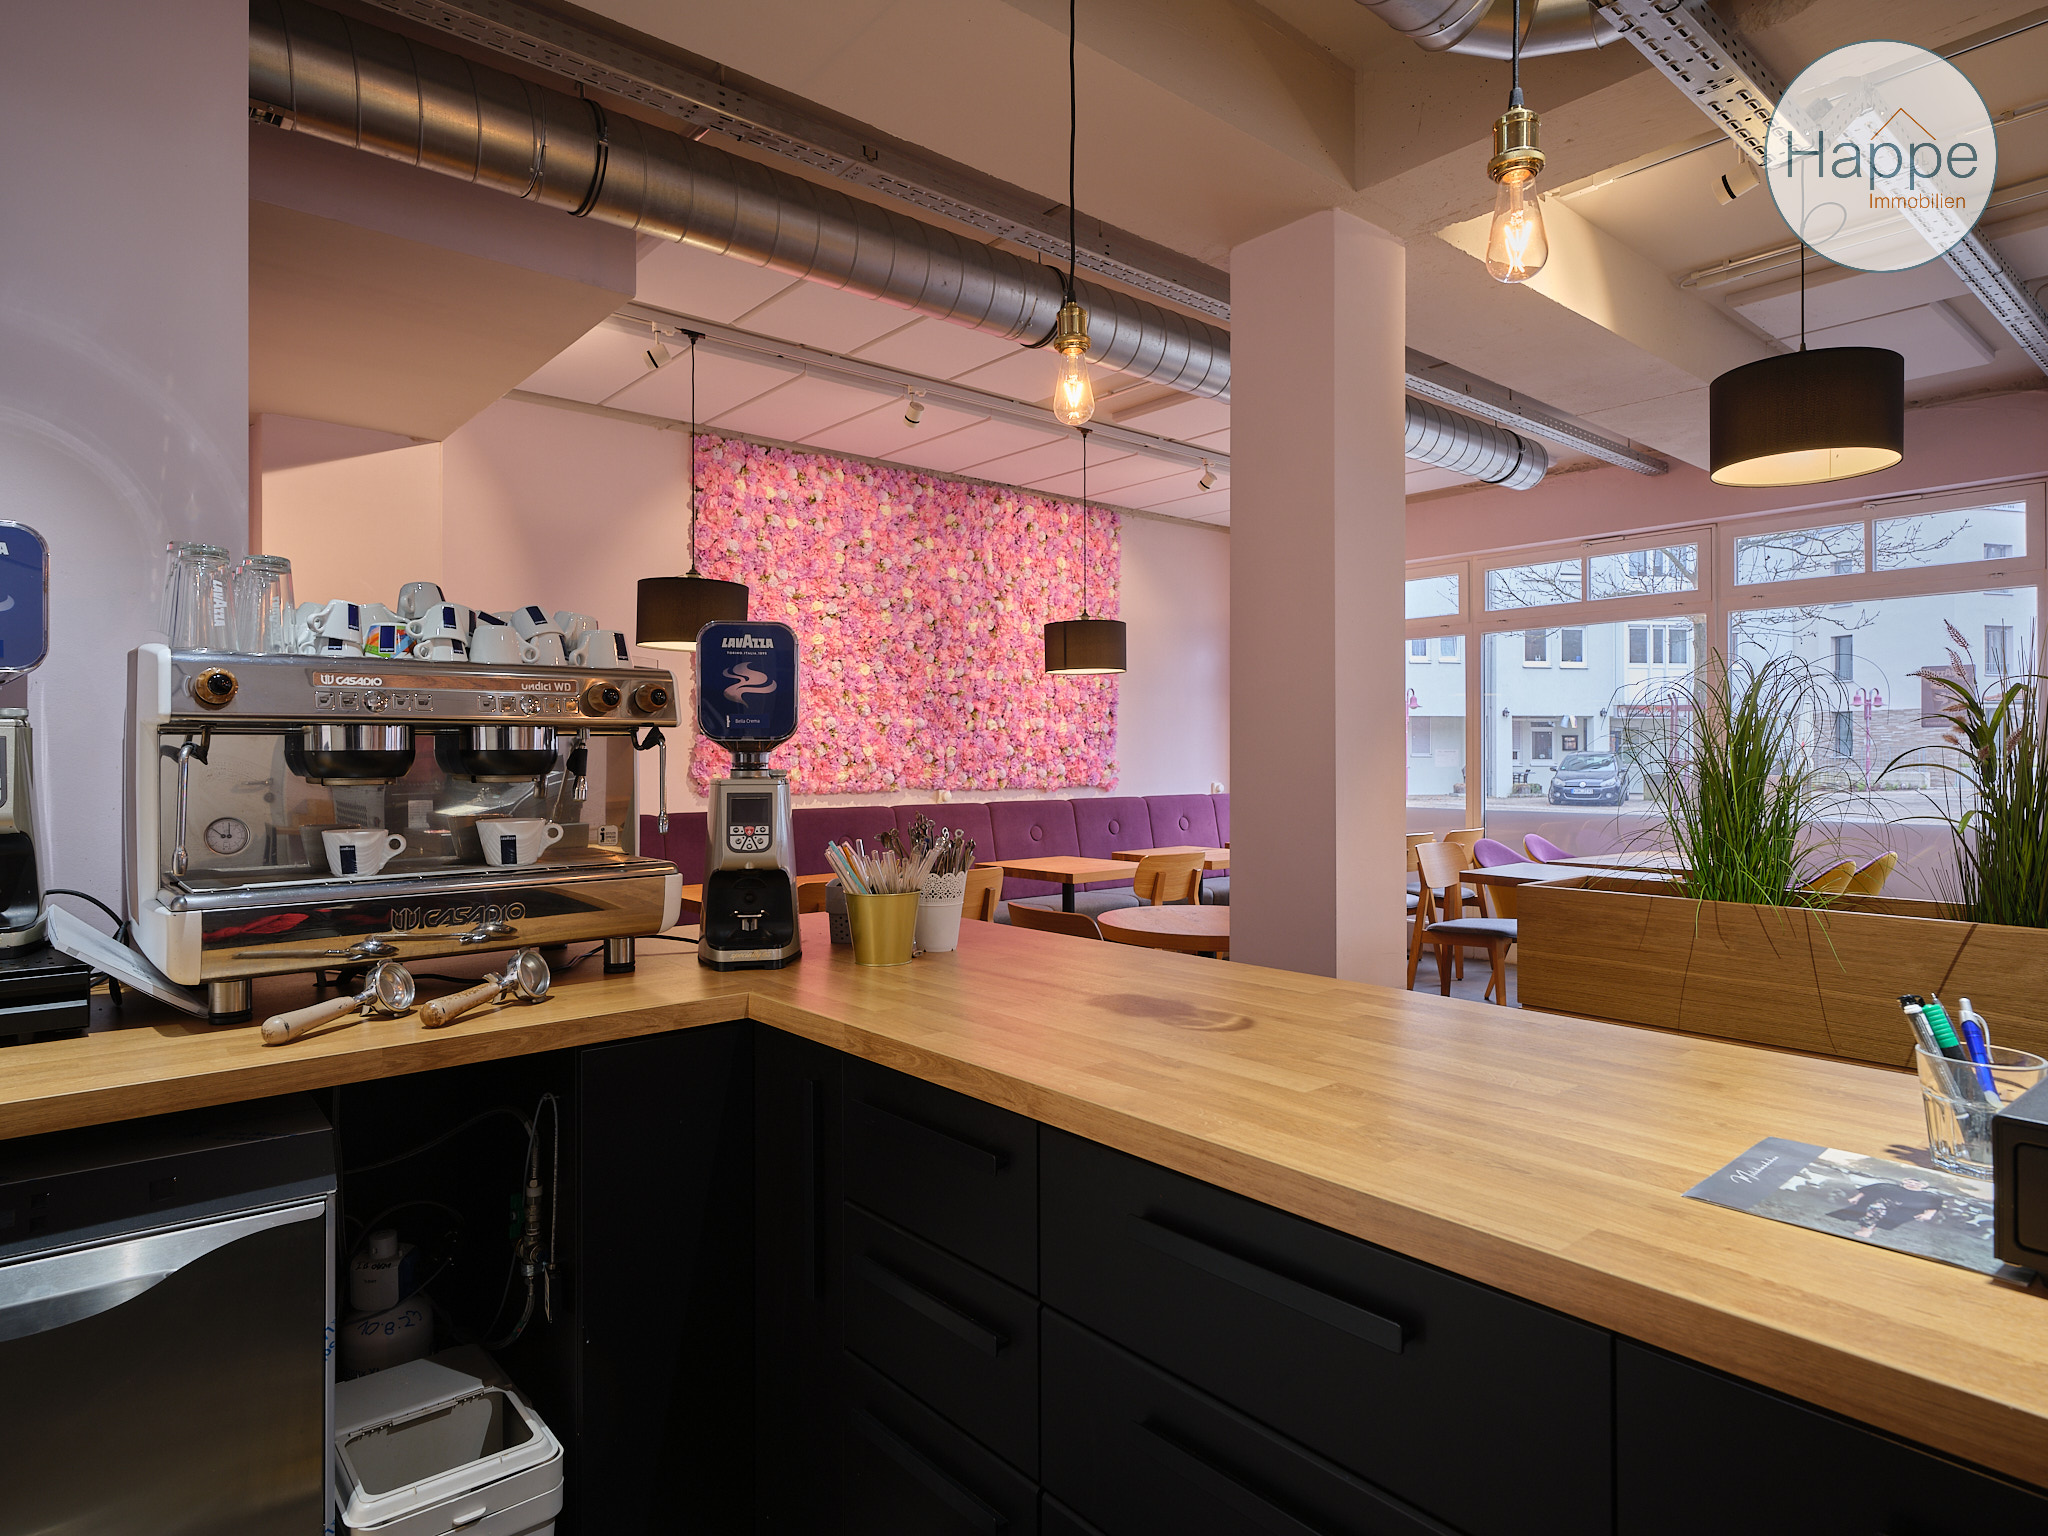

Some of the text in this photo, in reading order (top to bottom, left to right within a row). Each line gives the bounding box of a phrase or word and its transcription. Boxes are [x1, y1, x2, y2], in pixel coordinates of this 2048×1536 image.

[212, 579, 228, 627] LAVAZZA
[721, 633, 774, 649] LAVAZZA
[335, 676, 383, 687] CASADIO
[554, 682, 572, 692] WD
[424, 901, 526, 928] CASADIO
